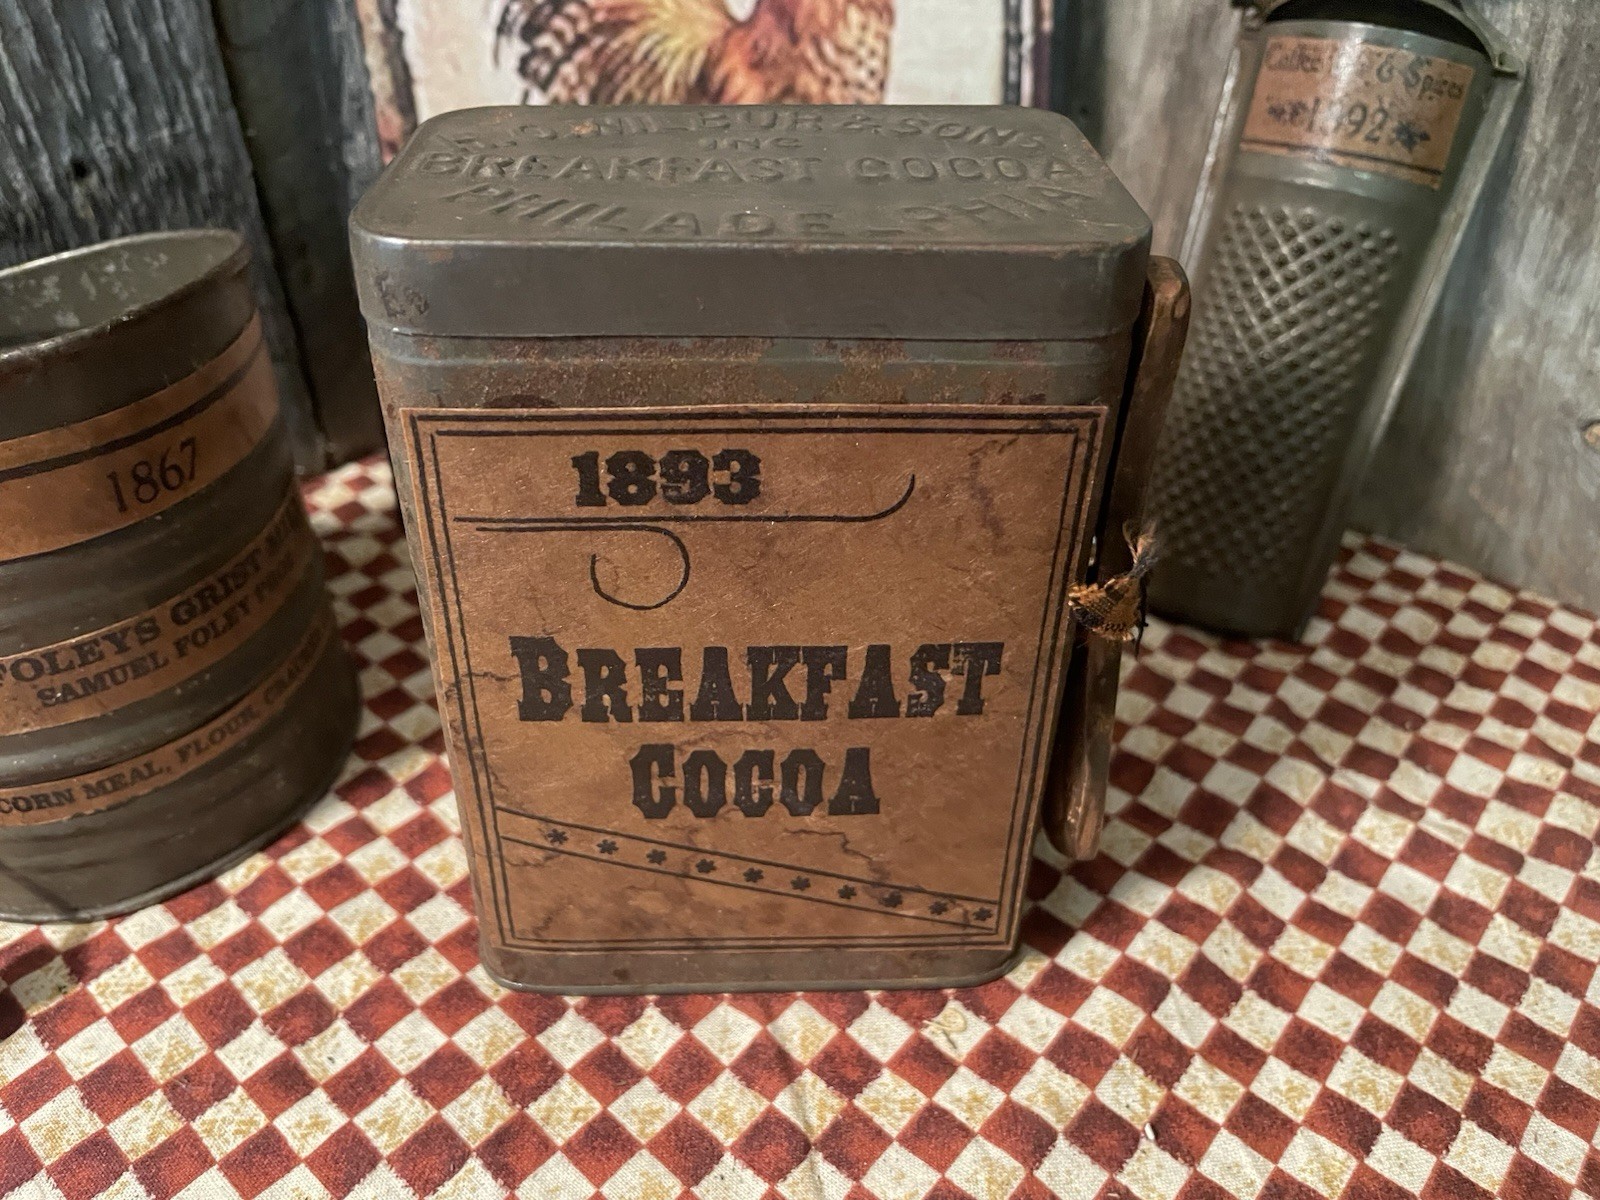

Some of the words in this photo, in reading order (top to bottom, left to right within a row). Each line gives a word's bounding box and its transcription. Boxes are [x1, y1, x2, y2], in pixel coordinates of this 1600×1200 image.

[1305, 96, 1388, 144] 192
[408, 150, 823, 186] BREAKFAST
[850, 155, 1090, 186] COCOA
[107, 436, 199, 513] 1867
[571, 448, 762, 507] 1893
[37, 651, 169, 708] SAMUEL
[174, 594, 251, 658] FOLEY
[508, 634, 1005, 723] BREAKFAST
[630, 744, 881, 819] COCOA
